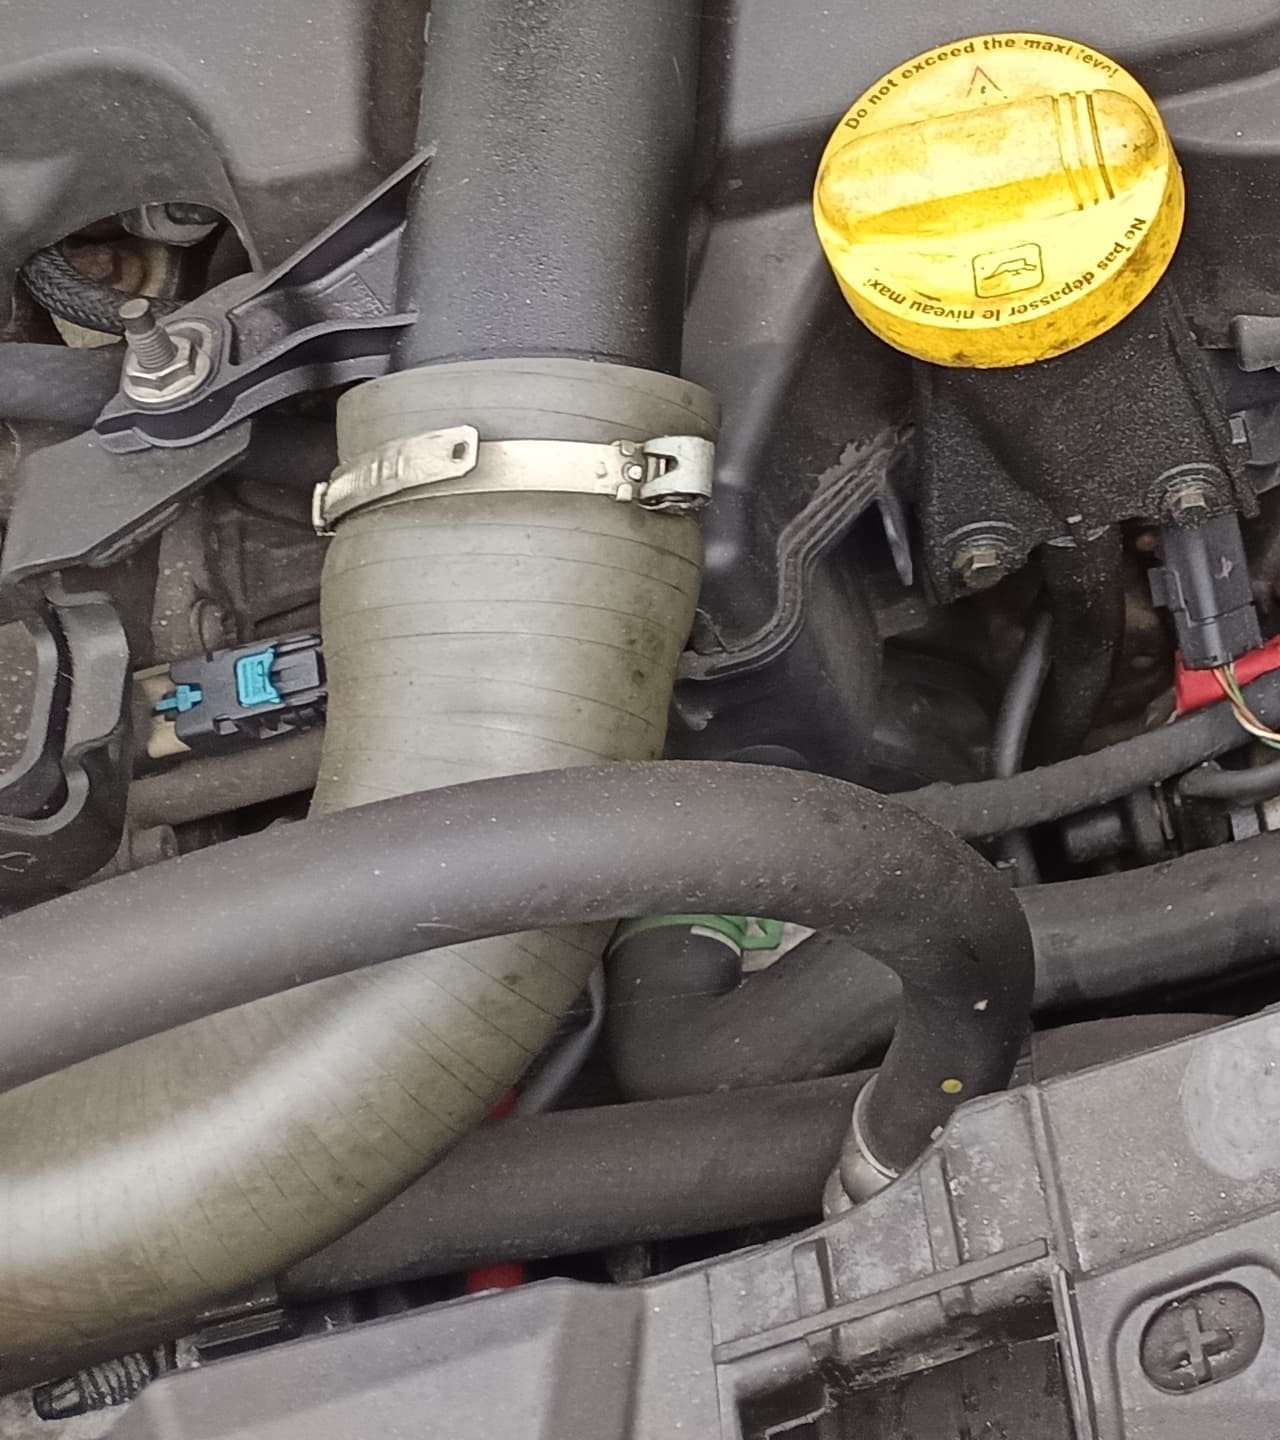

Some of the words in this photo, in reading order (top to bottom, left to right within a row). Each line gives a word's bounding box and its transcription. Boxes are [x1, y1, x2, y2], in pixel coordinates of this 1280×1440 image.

[845, 108, 868, 130] Do
[869, 80, 899, 108] not
[903, 42, 975, 80] exceed
[983, 37, 1016, 51] the
[1024, 39, 1073, 55] maxi
[1125, 217, 1147, 240] Ne
[1097, 242, 1128, 273] pas
[863, 277, 907, 307] maxi
[1008, 269, 1095, 317] dépasser
[909, 300, 974, 322] niveau
[982, 305, 1001, 321] le
